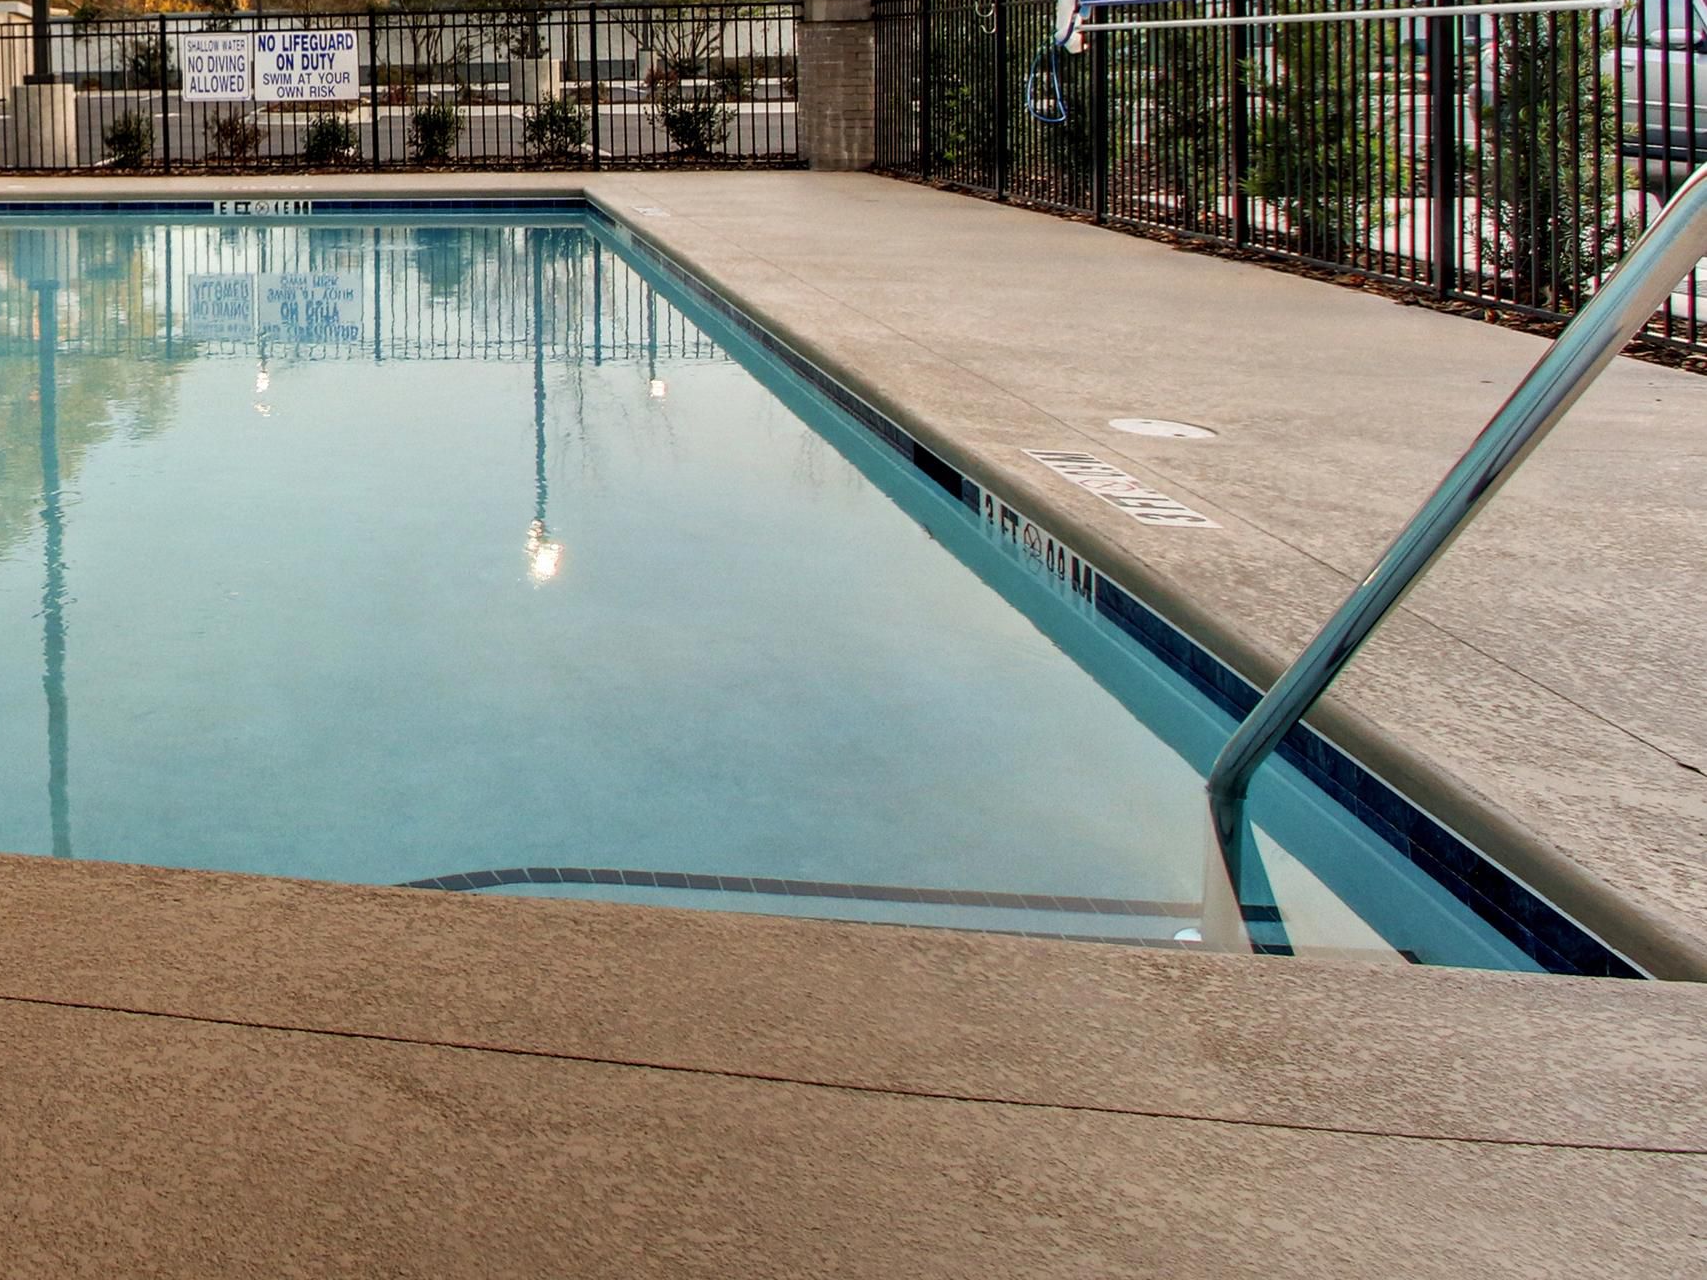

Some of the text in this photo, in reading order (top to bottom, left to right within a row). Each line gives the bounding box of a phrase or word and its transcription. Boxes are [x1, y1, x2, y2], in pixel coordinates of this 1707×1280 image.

[187, 39, 245, 52] SHALLOW WATER
[258, 34, 354, 52] NO LIFEGUARD
[188, 55, 245, 73] NO DIVING
[276, 53, 336, 71] ON DUTY
[190, 74, 245, 93] ALLOWED
[262, 72, 351, 86] SWIM AT YOUR
[276, 85, 336, 98] OWN RISK
[1099, 492, 1188, 511] FT
